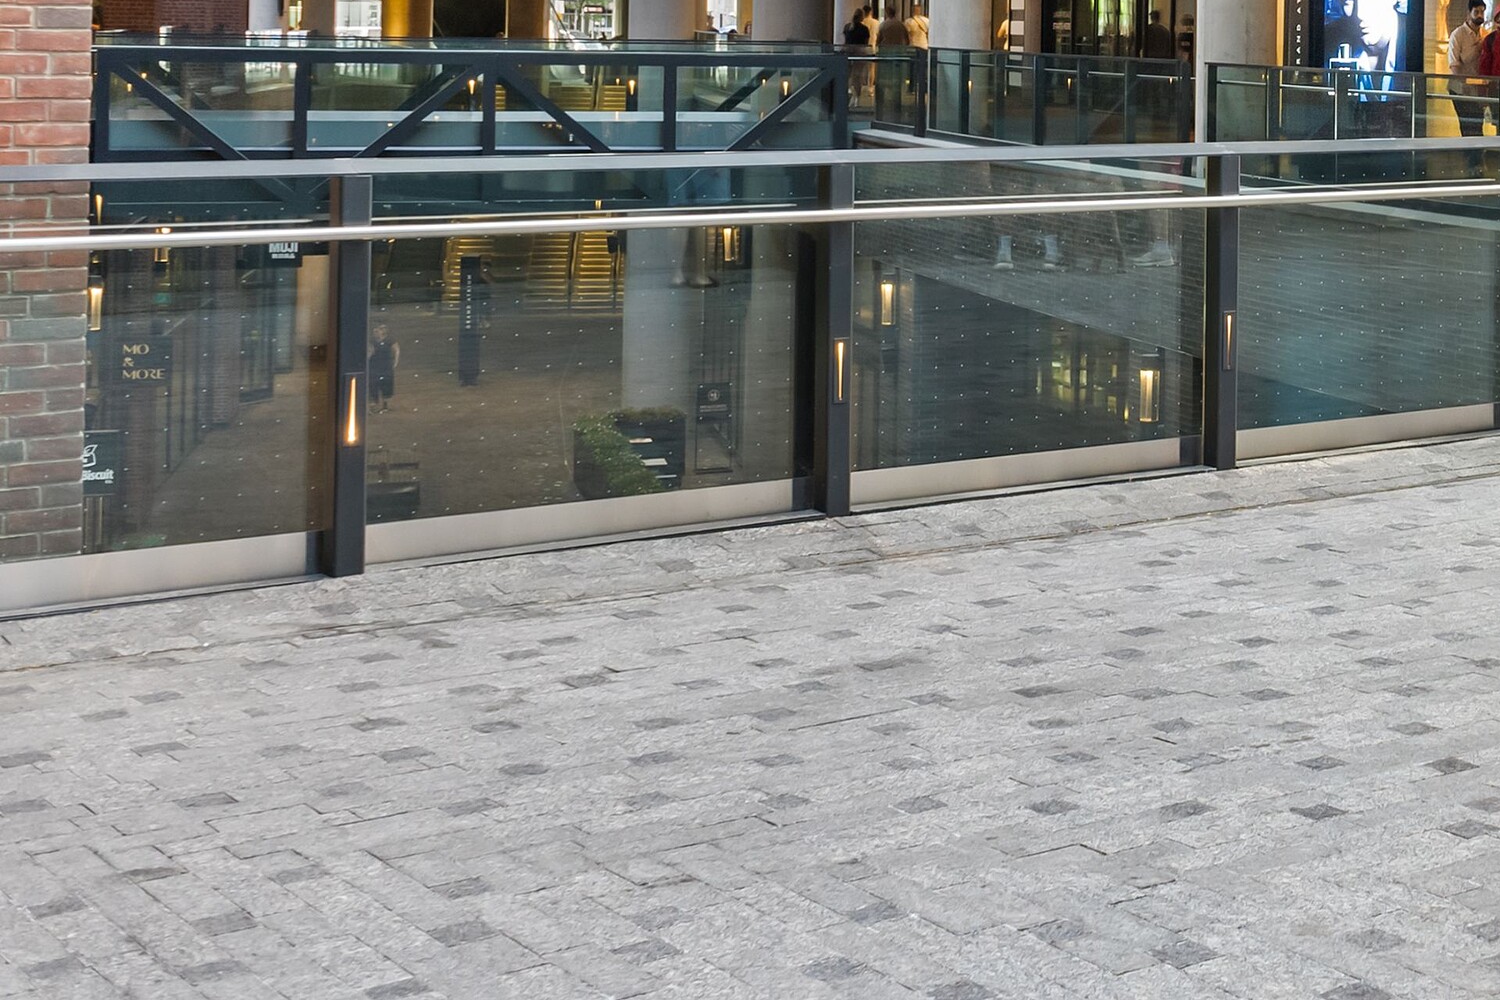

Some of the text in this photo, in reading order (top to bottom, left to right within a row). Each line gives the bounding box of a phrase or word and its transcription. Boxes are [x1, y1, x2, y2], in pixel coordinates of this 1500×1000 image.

[268, 241, 299, 253] MUJI
[122, 344, 149, 355] MO
[122, 357, 135, 367] &
[122, 368, 166, 379] MORE
